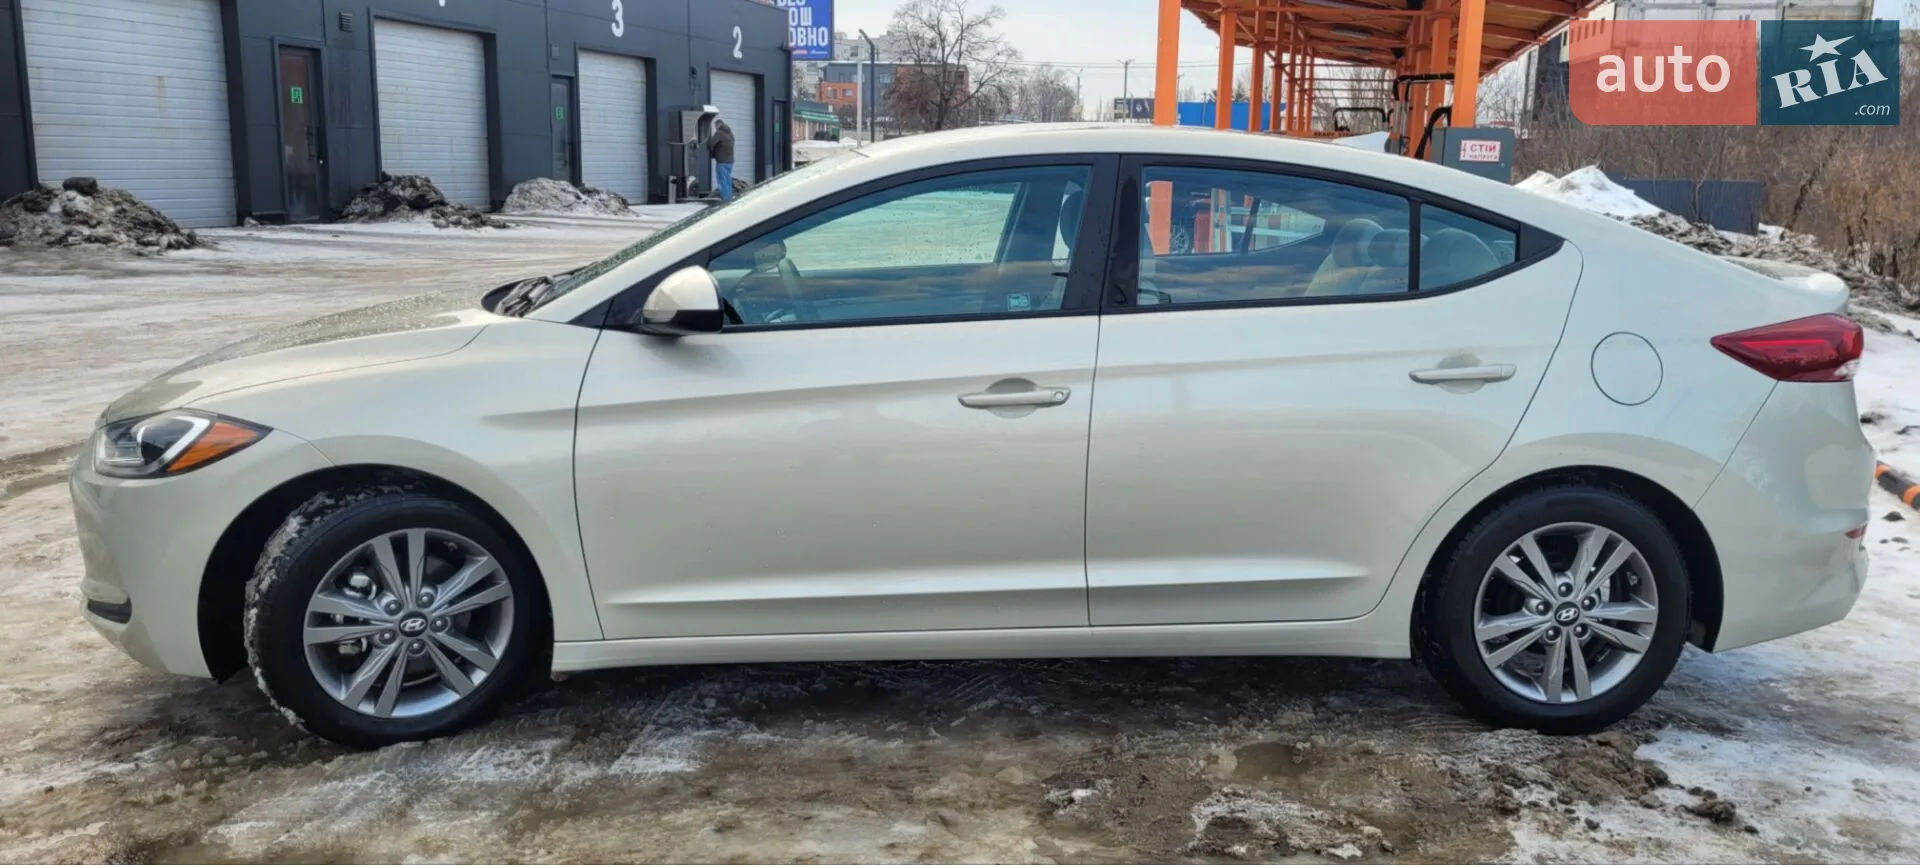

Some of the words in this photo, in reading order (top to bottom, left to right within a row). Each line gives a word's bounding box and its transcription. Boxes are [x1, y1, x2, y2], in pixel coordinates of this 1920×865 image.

[611, 0, 624, 37] 3
[788, 7, 812, 26] ОШ
[732, 25, 743, 59] 2
[788, 27, 828, 47] ОВНО
[1470, 143, 1497, 152] СТІЙ
